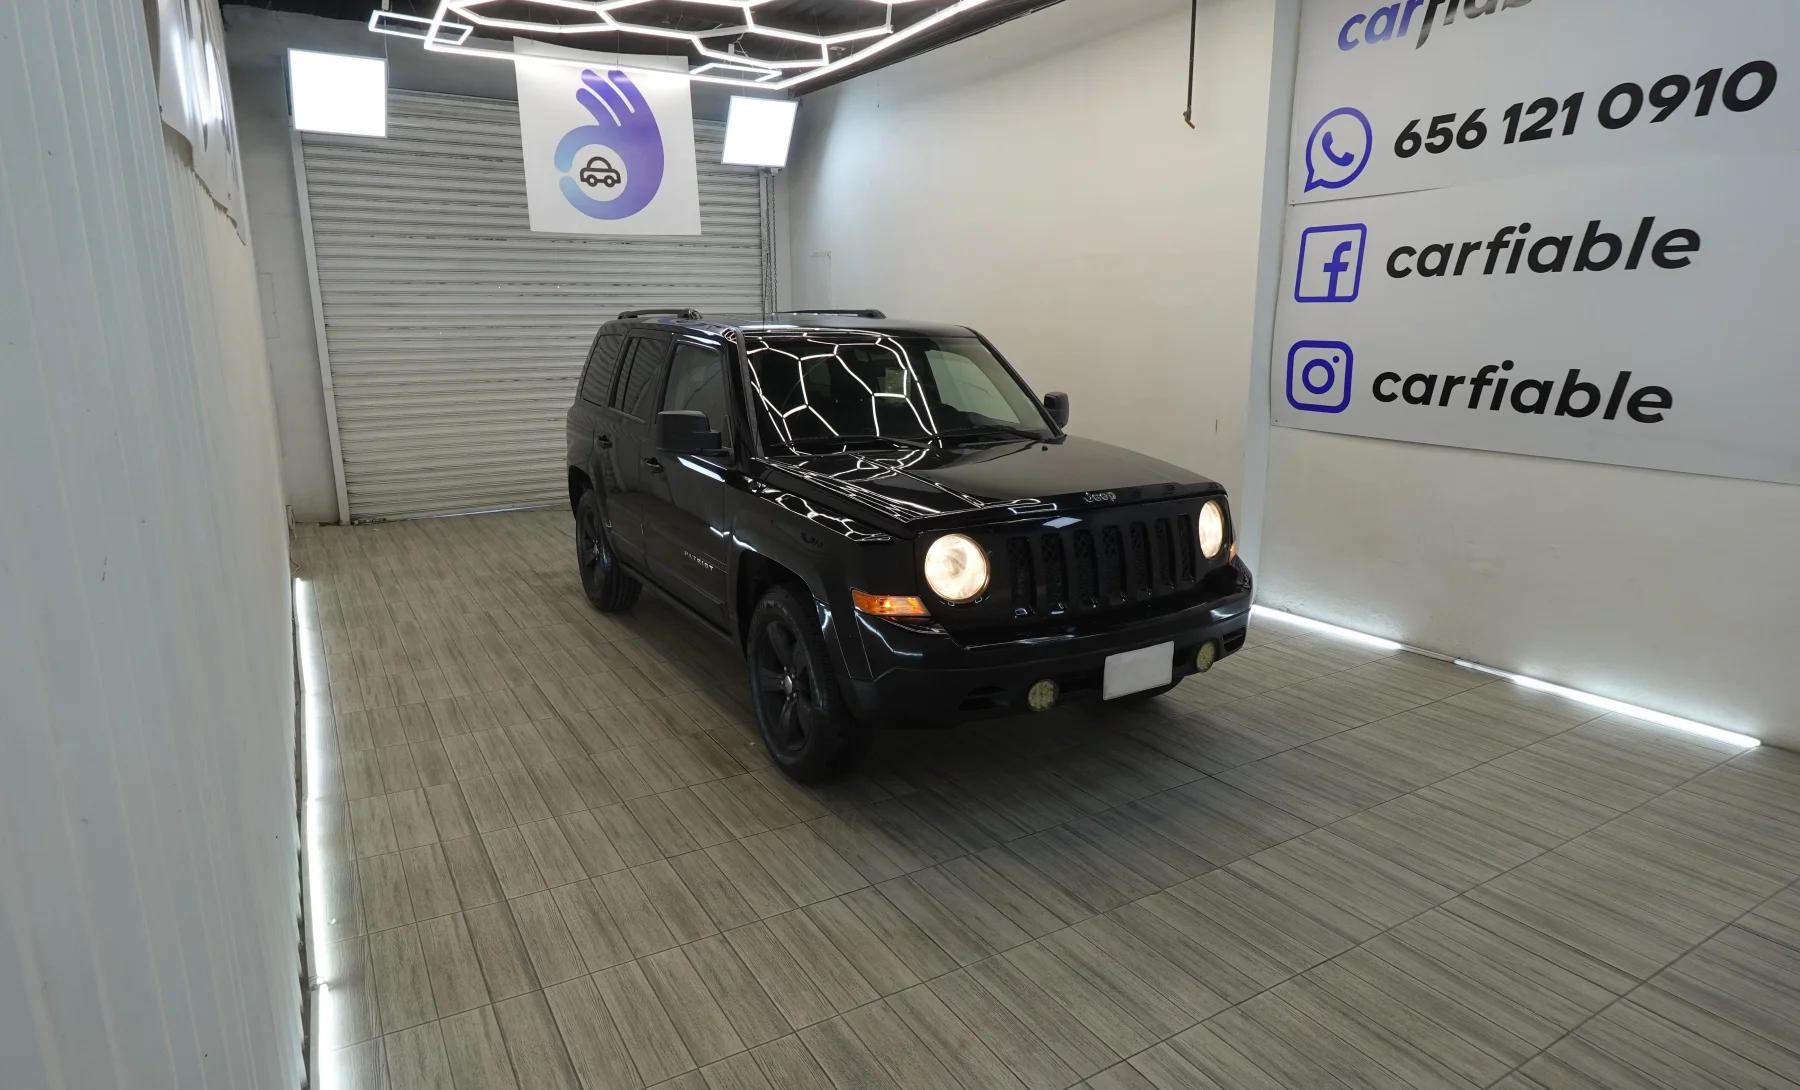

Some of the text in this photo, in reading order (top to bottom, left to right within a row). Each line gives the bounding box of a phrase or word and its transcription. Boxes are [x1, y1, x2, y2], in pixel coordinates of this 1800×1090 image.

[1393, 60, 1778, 159] 656 121 0910
[1386, 216, 1701, 279] carfiable
[1372, 359, 1674, 424] carfiable
[1083, 491, 1117, 503] Jeep
[684, 550, 714, 571] PATRIOT
